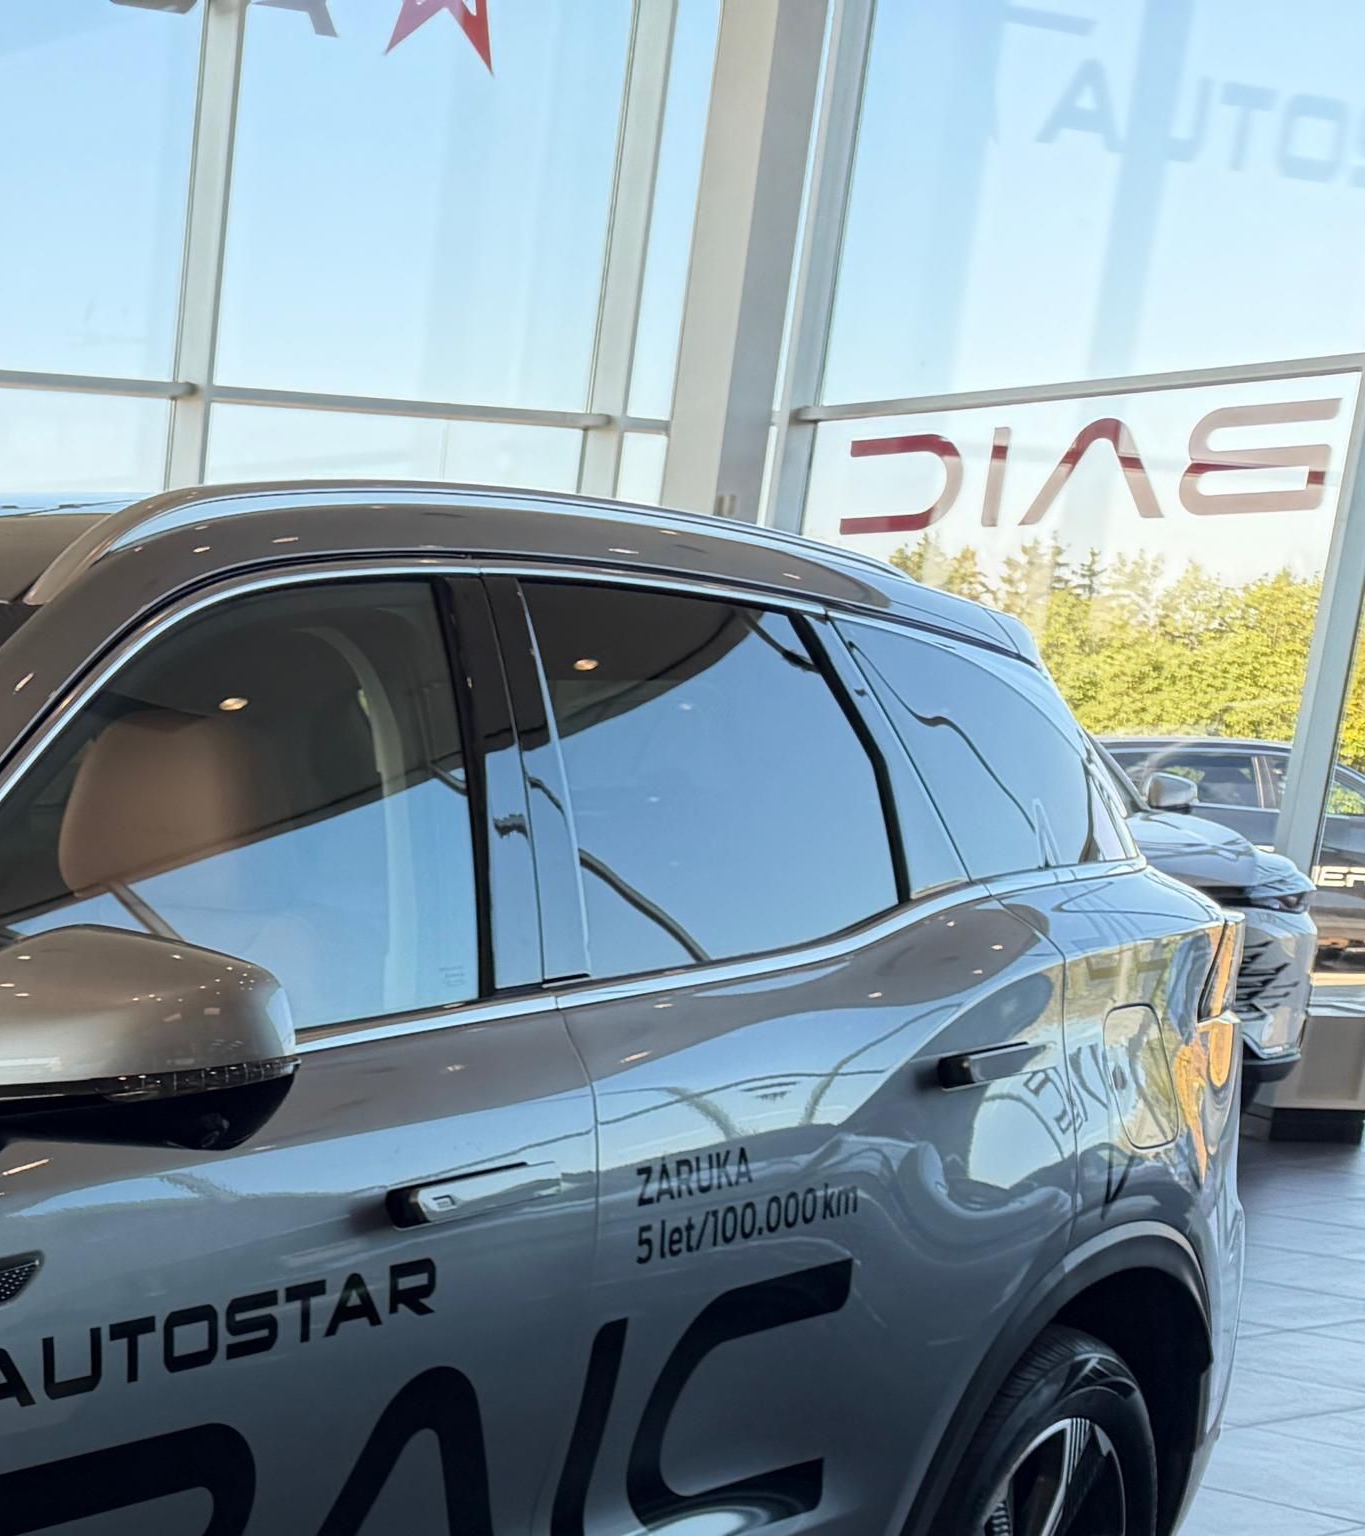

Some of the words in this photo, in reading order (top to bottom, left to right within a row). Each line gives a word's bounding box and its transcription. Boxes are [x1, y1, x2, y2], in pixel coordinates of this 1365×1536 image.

[636, 1223, 654, 1265] 5
[659, 1186, 818, 1259] let/100.000
[822, 1182, 859, 1221] km
